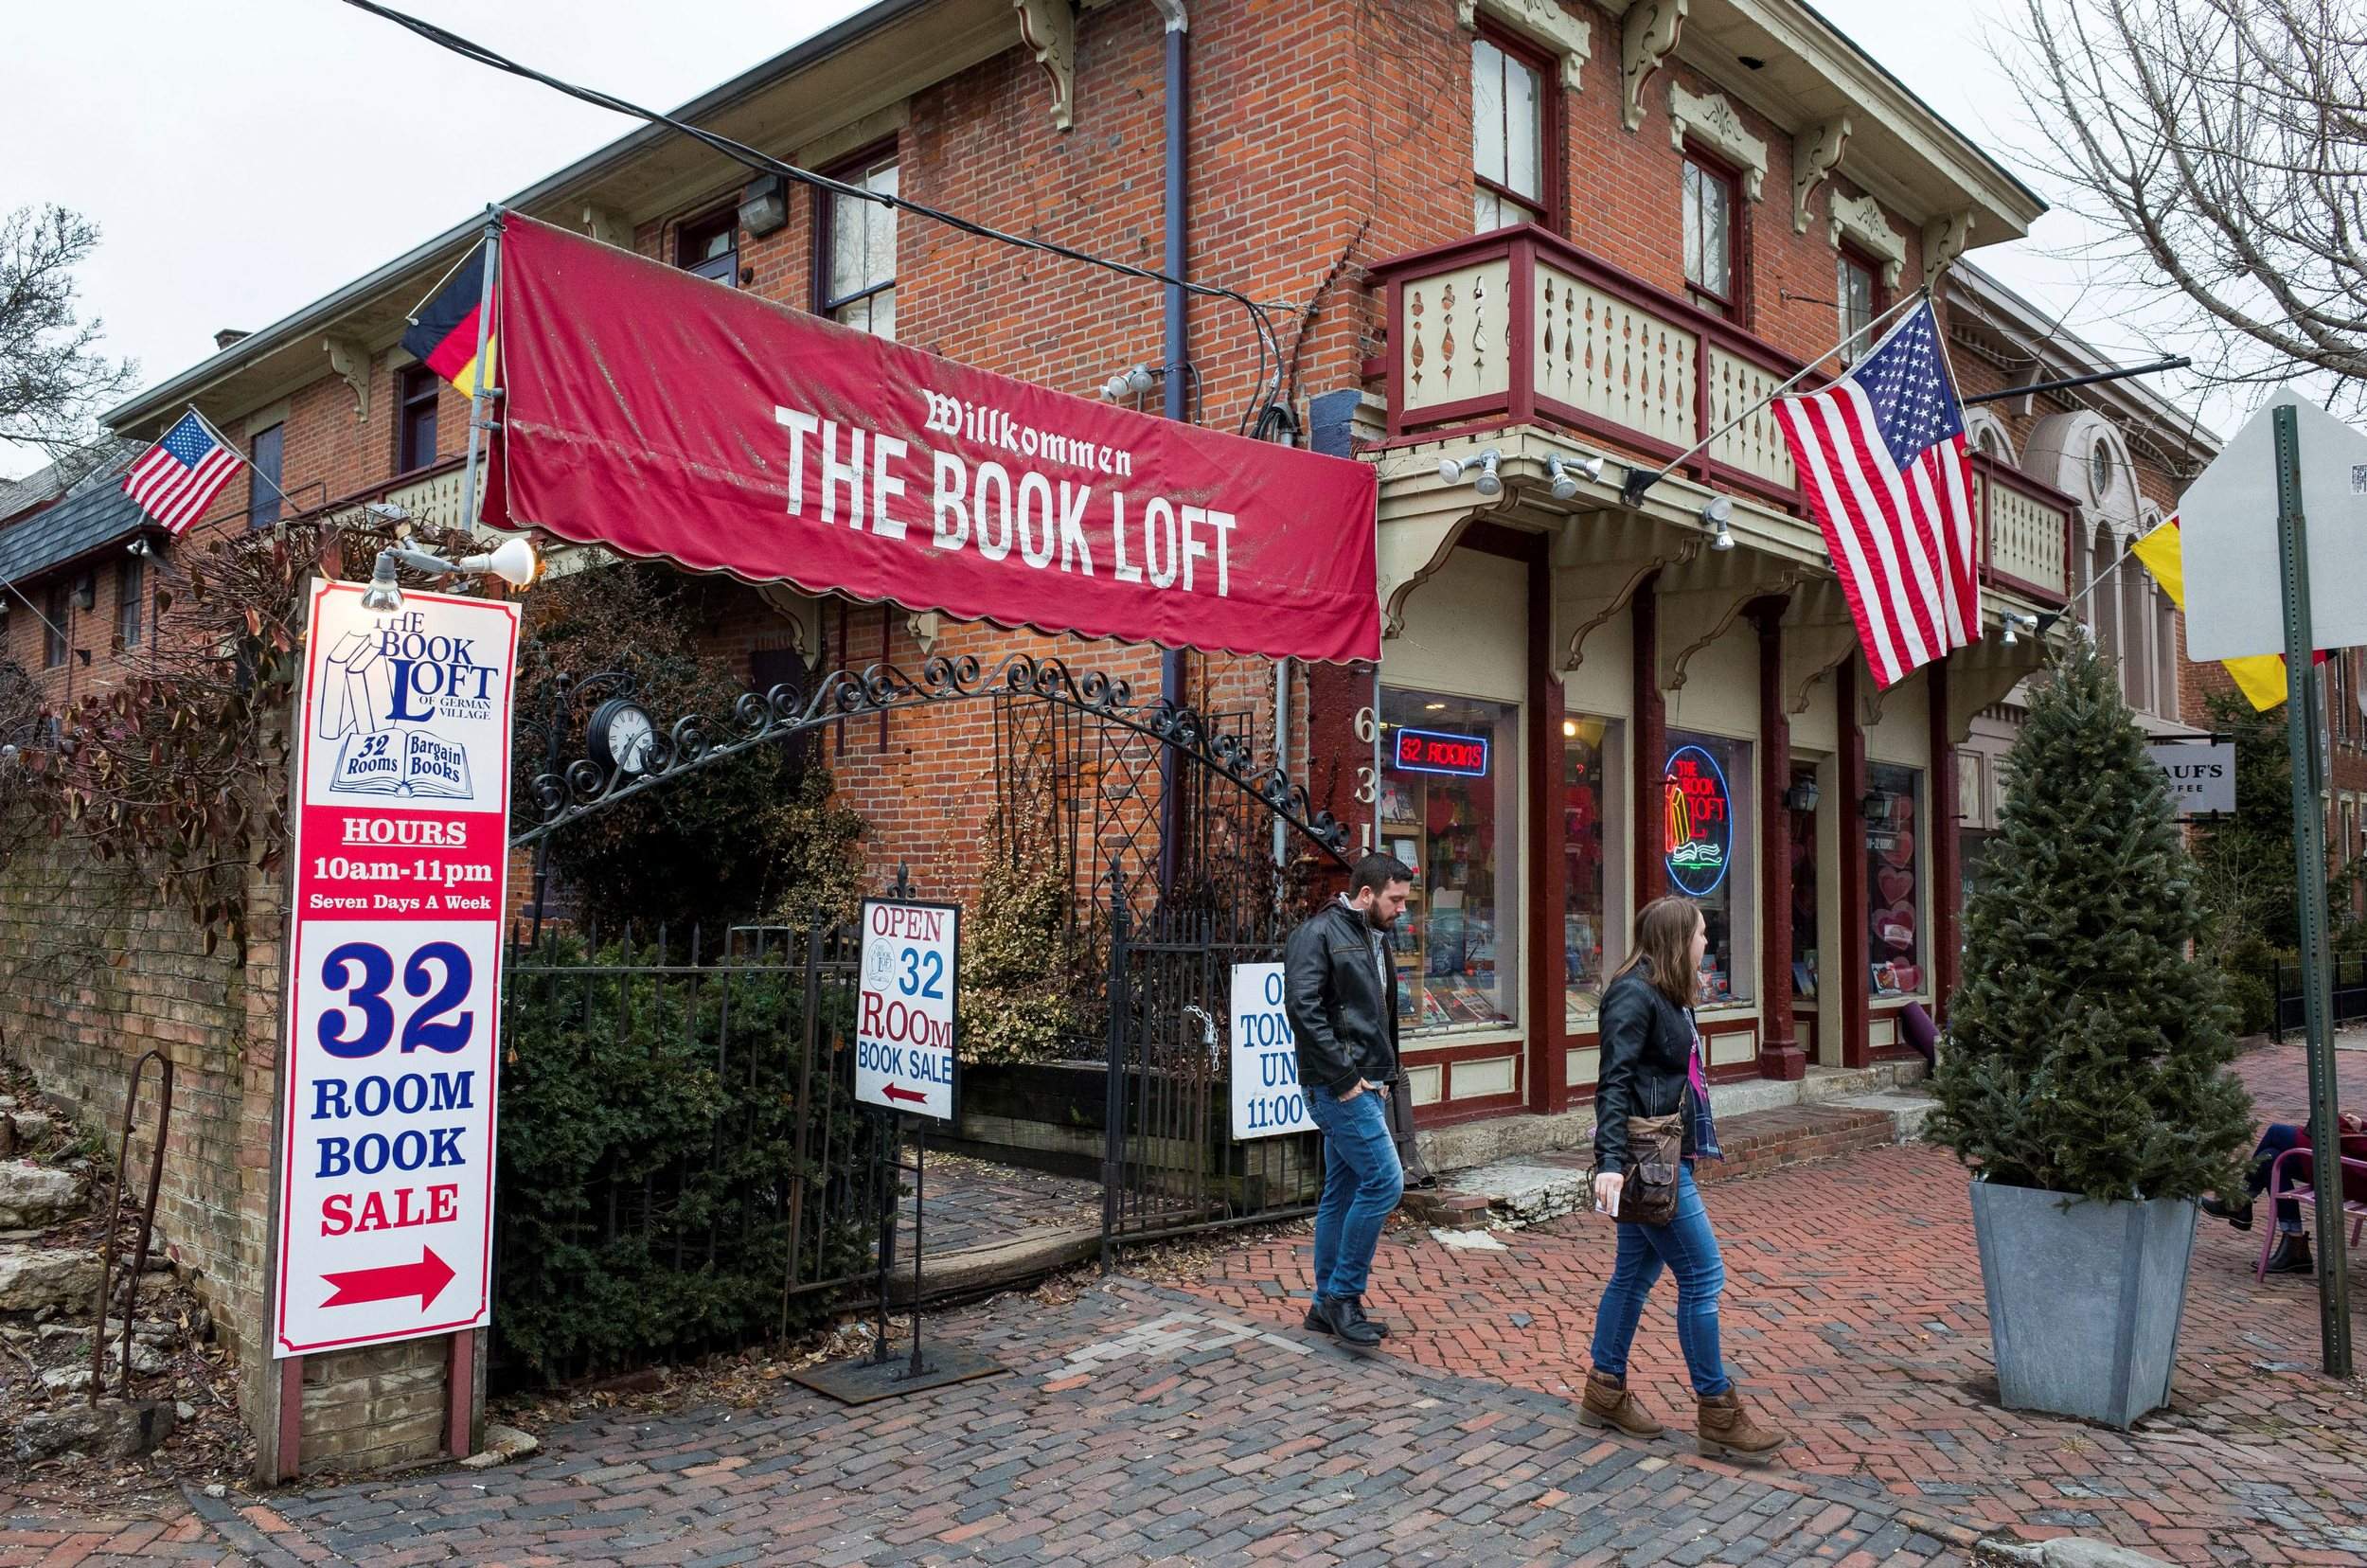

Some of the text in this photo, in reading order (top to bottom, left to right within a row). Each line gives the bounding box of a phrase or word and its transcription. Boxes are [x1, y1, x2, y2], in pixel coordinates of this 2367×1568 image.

[922, 388, 1132, 477] Willkommen
[774, 404, 1237, 597] THE BOOK LOFT
[379, 630, 475, 665] BOOK
[384, 658, 499, 722] LOFT
[418, 695, 491, 710] OF GERMAN
[440, 707, 491, 721] VILLAGE
[358, 735, 390, 758] 32
[410, 736, 461, 766] Bargain
[1400, 738, 1482, 768] 32 ROOMS
[347, 757, 398, 775] Rooms
[410, 757, 460, 783] Books
[1676, 760, 1698, 777] THE
[1682, 777, 1716, 796] BOOK
[342, 818, 468, 846] HOURS
[1687, 796, 1725, 839] LOFT
[313, 857, 493, 888] 10am-11pm
[310, 894, 491, 913] Seven Days A Week
[872, 905, 945, 942] OPEN
[899, 947, 944, 1000] 32
[317, 941, 474, 1059] 32
[860, 990, 952, 1049] ROOM
[859, 1042, 952, 1085] BOOK SALE
[311, 1071, 475, 1119] ROOM
[1248, 1094, 1303, 1129] 11:00
[315, 1127, 467, 1178] BOOK
[321, 1183, 459, 1237] SALE
